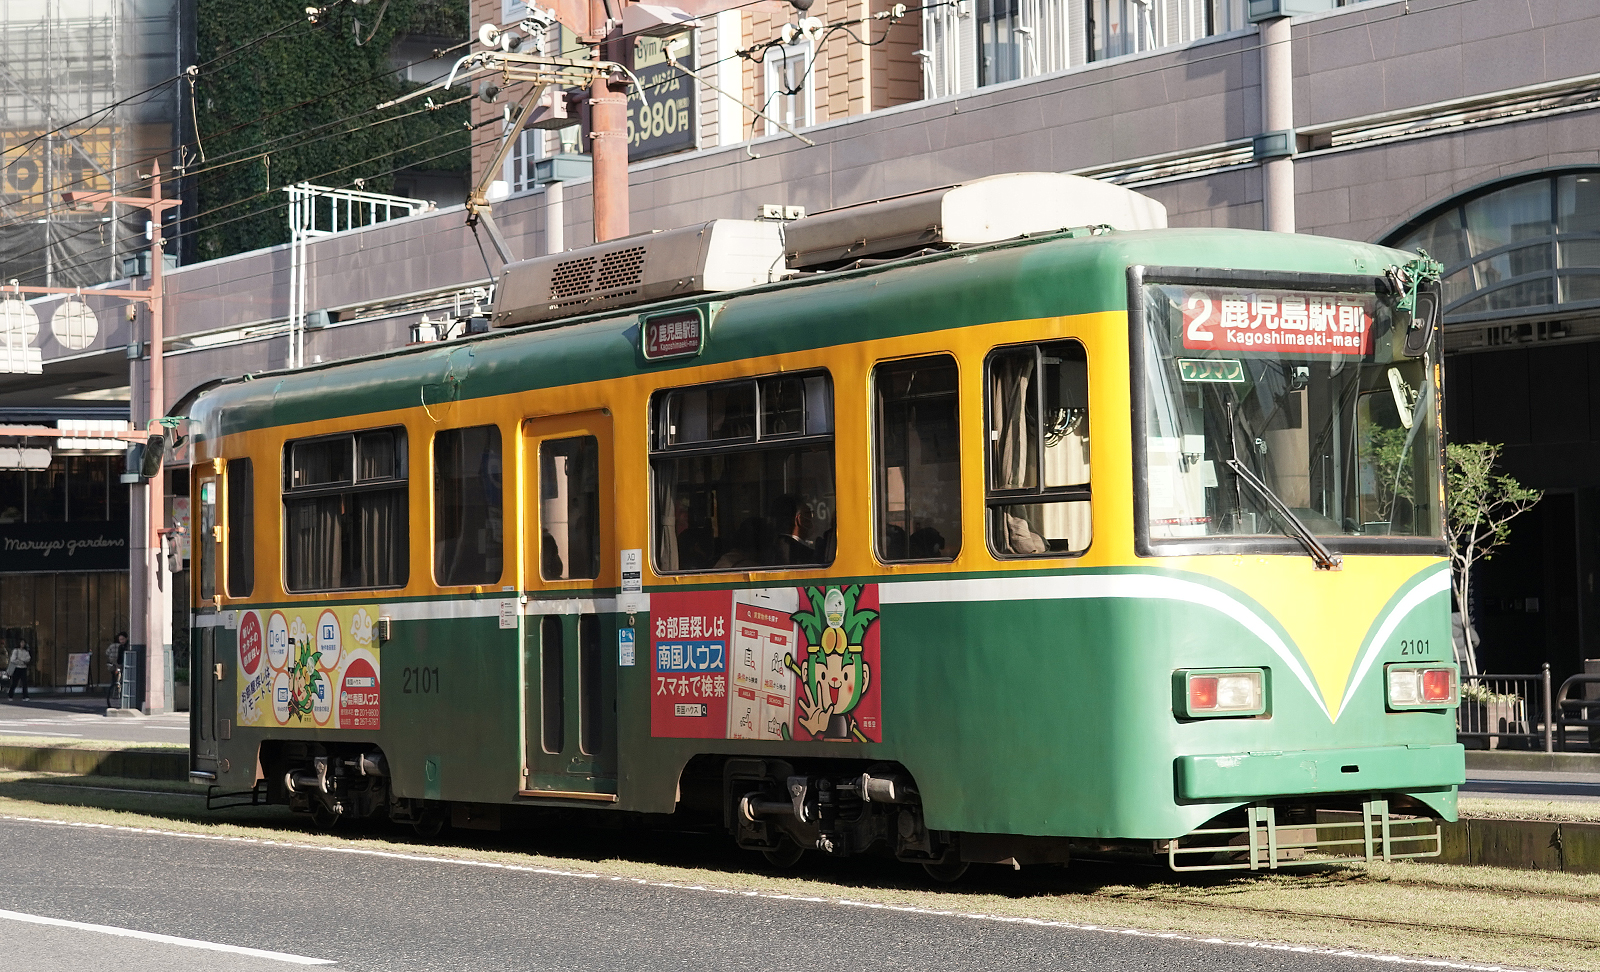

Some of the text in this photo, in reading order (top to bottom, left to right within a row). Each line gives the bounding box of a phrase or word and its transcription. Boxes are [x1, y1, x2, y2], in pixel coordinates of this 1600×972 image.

[1186, 292, 1365, 341] 2 鹿児島駅前
[650, 319, 699, 352] 2 鹿児島駅前
[1227, 329, 1361, 347] Kagoshimaeki-mae
[5, 535, 125, 556] Maruya gardens
[655, 616, 725, 639] お部屋探しは
[658, 645, 723, 670] 南国ハウス
[1400, 639, 1429, 656] 2101
[403, 666, 439, 694] 2101
[656, 675, 726, 698] スマホで検索
